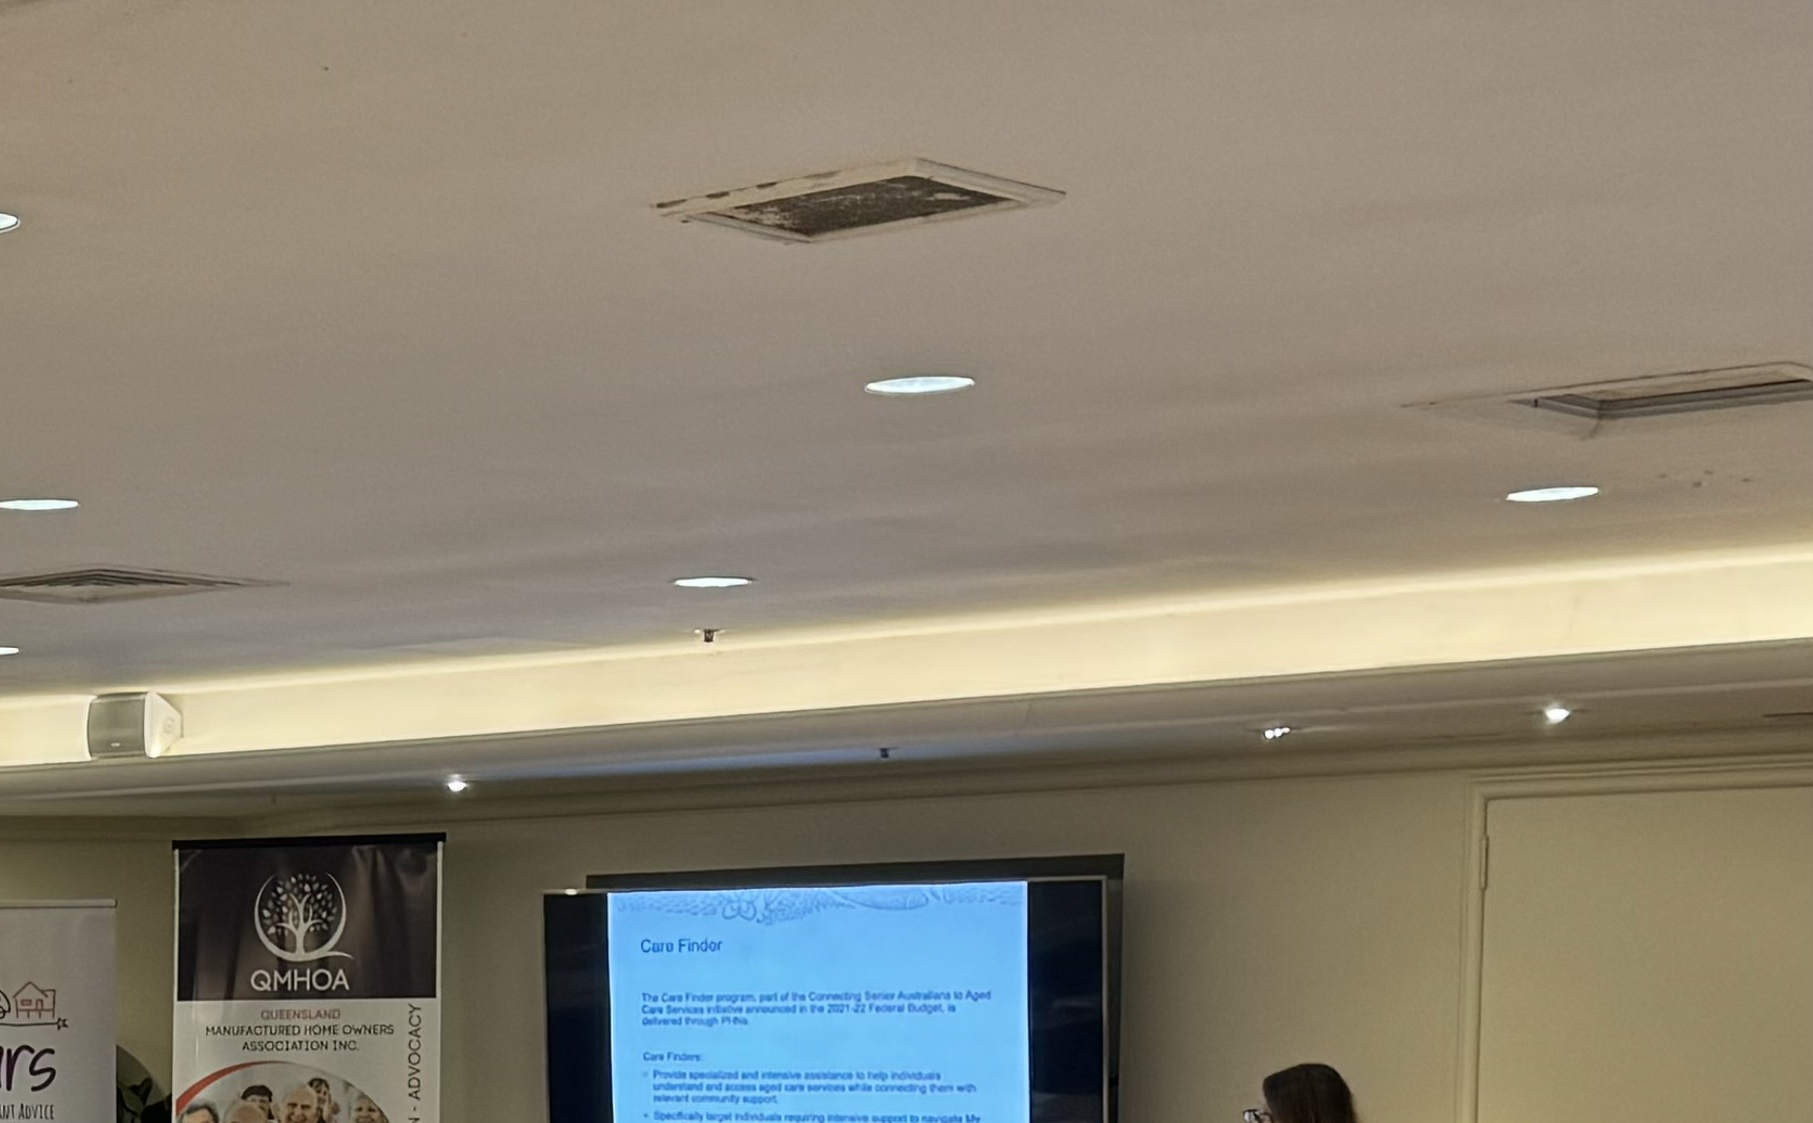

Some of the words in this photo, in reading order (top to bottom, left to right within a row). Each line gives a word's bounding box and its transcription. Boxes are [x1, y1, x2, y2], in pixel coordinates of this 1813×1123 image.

[640, 938, 674, 953] Care
[678, 938, 723, 953] Finder
[250, 968, 350, 992] QMHOA
[642, 992, 659, 1002] The
[661, 992, 683, 1002] Care
[685, 992, 713, 1002] Finder
[759, 992, 778, 1004] part
[780, 992, 789, 1002] of
[791, 992, 806, 1002] the
[808, 991, 862, 1002] Connecting
[865, 990, 895, 1001] Senior
[897, 990, 951, 1000] Australians
[965, 990, 991, 1002] Aged
[261, 1008, 340, 1020] QUEENSLAND
[641, 1005, 663, 1014] Care
[666, 1005, 704, 1015] Services
[746, 1004, 797, 1014] announced
[799, 1004, 807, 1013] in
[810, 1004, 824, 1013] the
[868, 1003, 905, 1013] Federal
[642, 1016, 682, 1026] delivered
[685, 1016, 718, 1028] through
[205, 1025, 301, 1036] MANUFACTURED
[304, 1024, 339, 1036] HOME
[342, 1024, 395, 1035] OWNERS
[242, 1041, 329, 1052] ASSOCIATION
[408, 1003, 422, 1100] ADVOCACY
[643, 1052, 664, 1061] Care
[653, 1069, 687, 1079] Provide
[741, 1070, 759, 1080] and
[761, 1070, 802, 1080] intensive
[804, 1071, 853, 1081] assistance
[856, 1071, 864, 1080] to
[867, 1071, 888, 1083] help
[891, 1071, 941, 1081] individuals
[653, 1082, 703, 1092] understand
[706, 1083, 722, 1092] and
[725, 1084, 757, 1092] access
[759, 1083, 782, 1094] aged
[784, 1084, 805, 1092] care
[807, 1084, 846, 1093] services
[848, 1083, 872, 1093] while
[875, 1083, 927, 1095] connecting
[929, 1083, 954, 1093] them
[957, 1083, 976, 1094] with
[653, 1094, 689, 1104] relevant
[692, 1094, 740, 1106] community
[654, 1111, 704, 1123] Specifically
[706, 1111, 732, 1123] target
[735, 1112, 782, 1122] individuals
[827, 1114, 869, 1123] intensive
[910, 1114, 919, 1123] to
